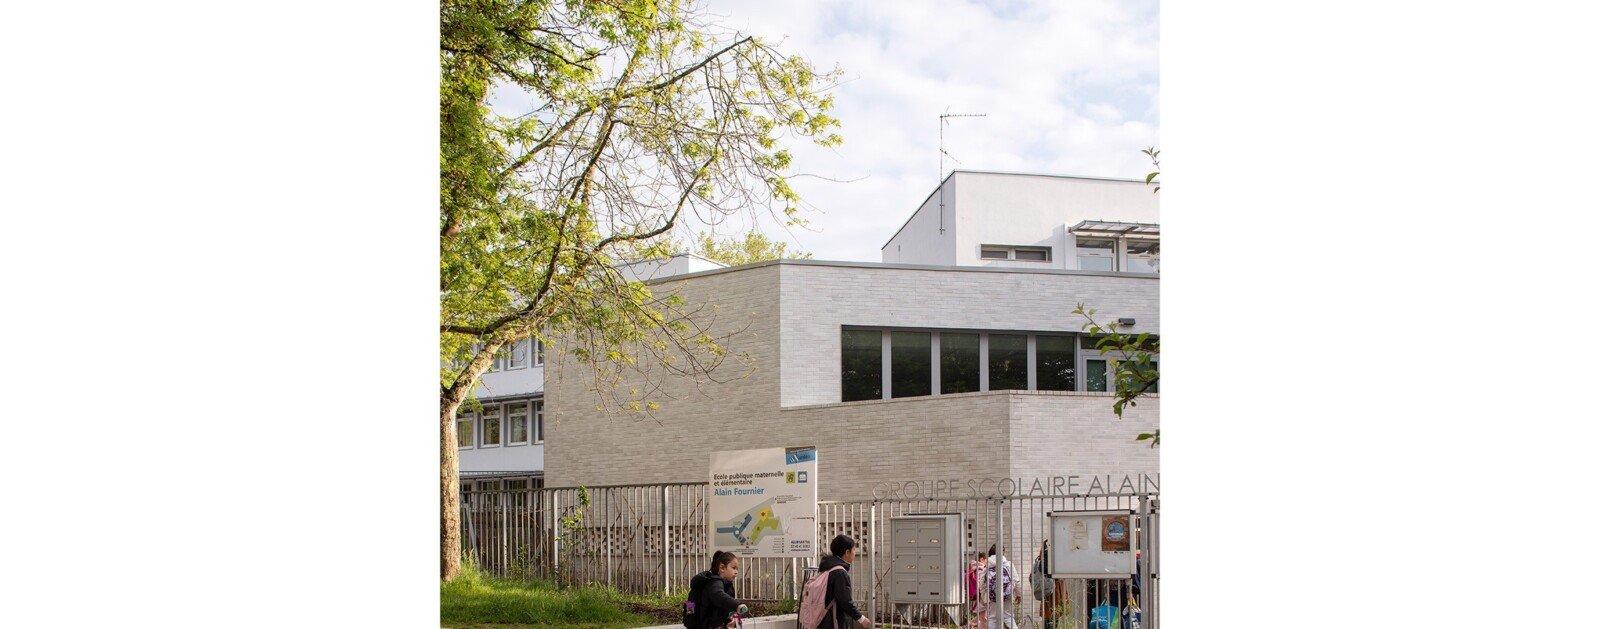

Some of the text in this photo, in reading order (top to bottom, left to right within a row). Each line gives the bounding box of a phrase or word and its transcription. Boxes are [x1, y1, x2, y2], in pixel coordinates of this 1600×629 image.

[729, 472, 753, 481] publique
[872, 472, 1160, 499] GROUPE SCOLAIRE ALAIN
[714, 487, 764, 496] Alain Fournier
